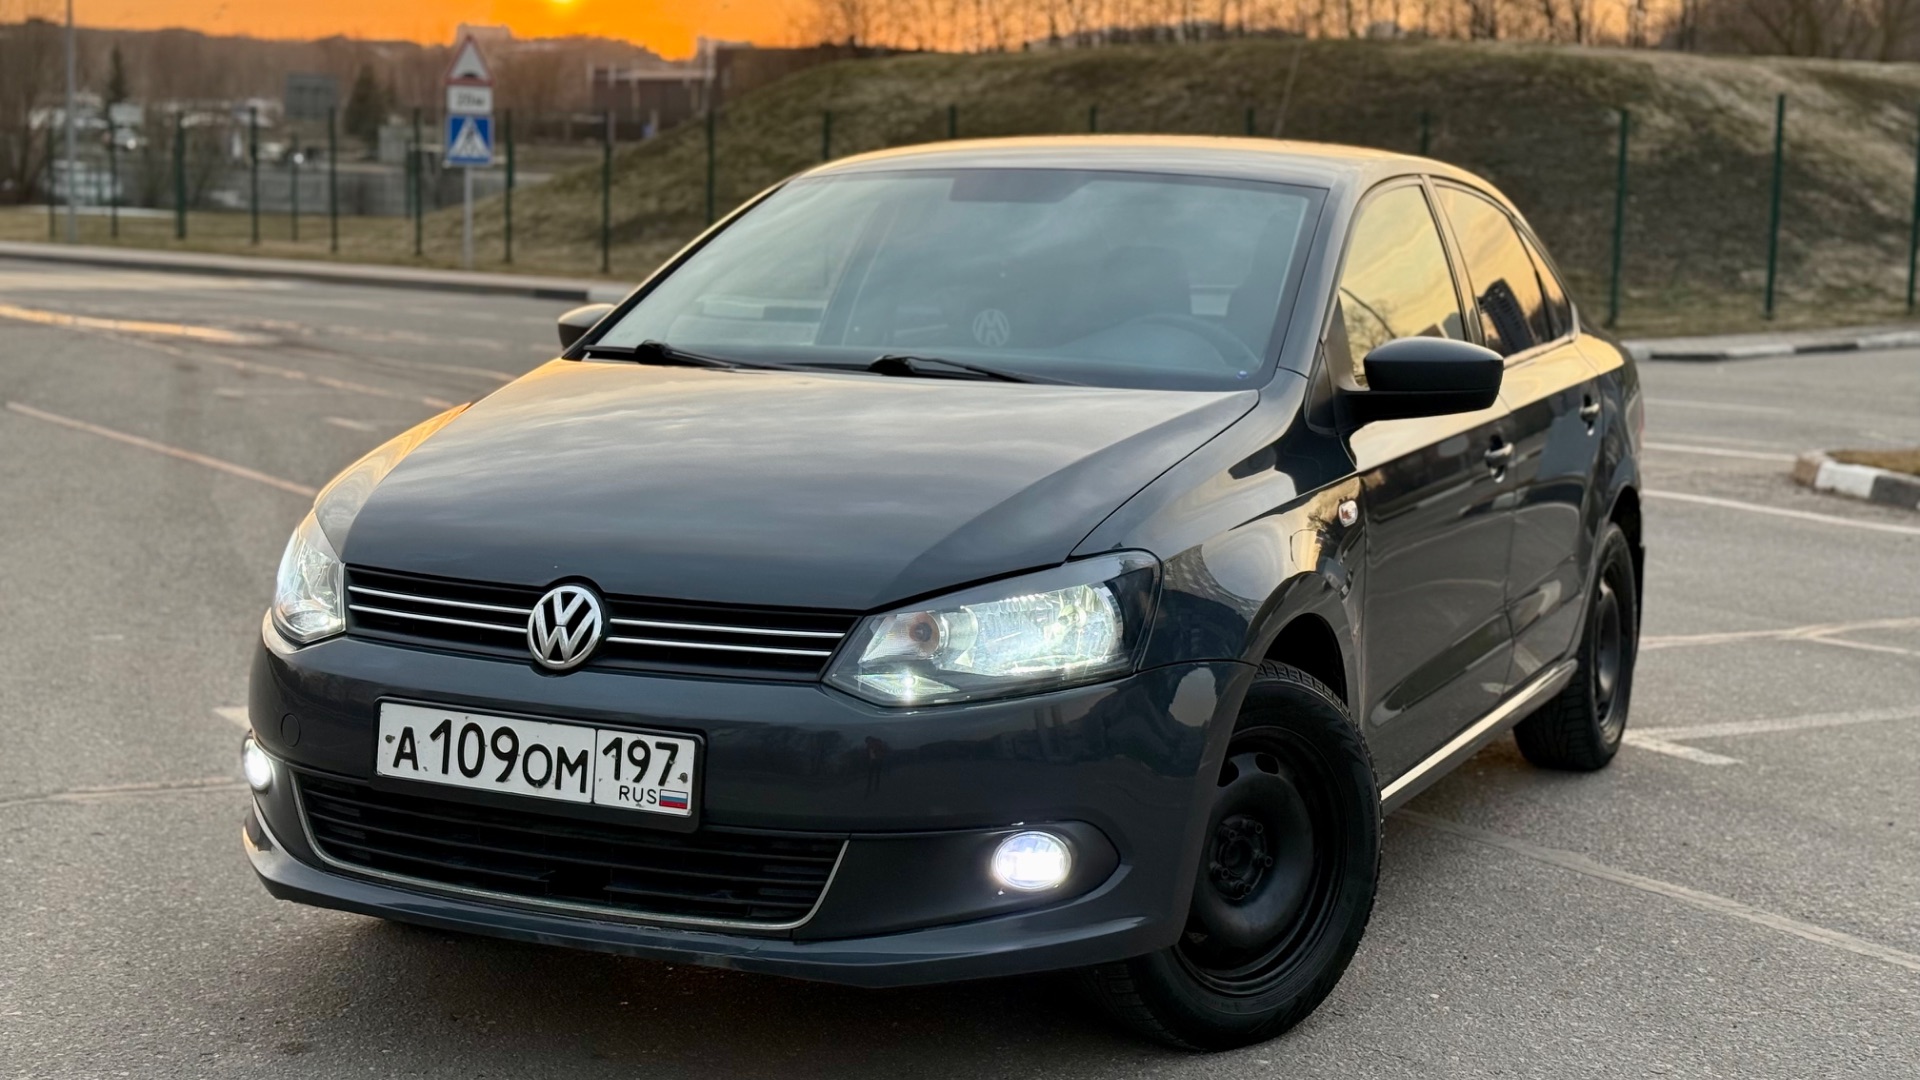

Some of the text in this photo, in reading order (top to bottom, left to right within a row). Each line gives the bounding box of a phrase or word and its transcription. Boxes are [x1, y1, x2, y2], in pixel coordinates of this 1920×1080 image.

[528, 586, 602, 669] VW
[602, 736, 679, 787] 197
[618, 785, 658, 805] RUS
